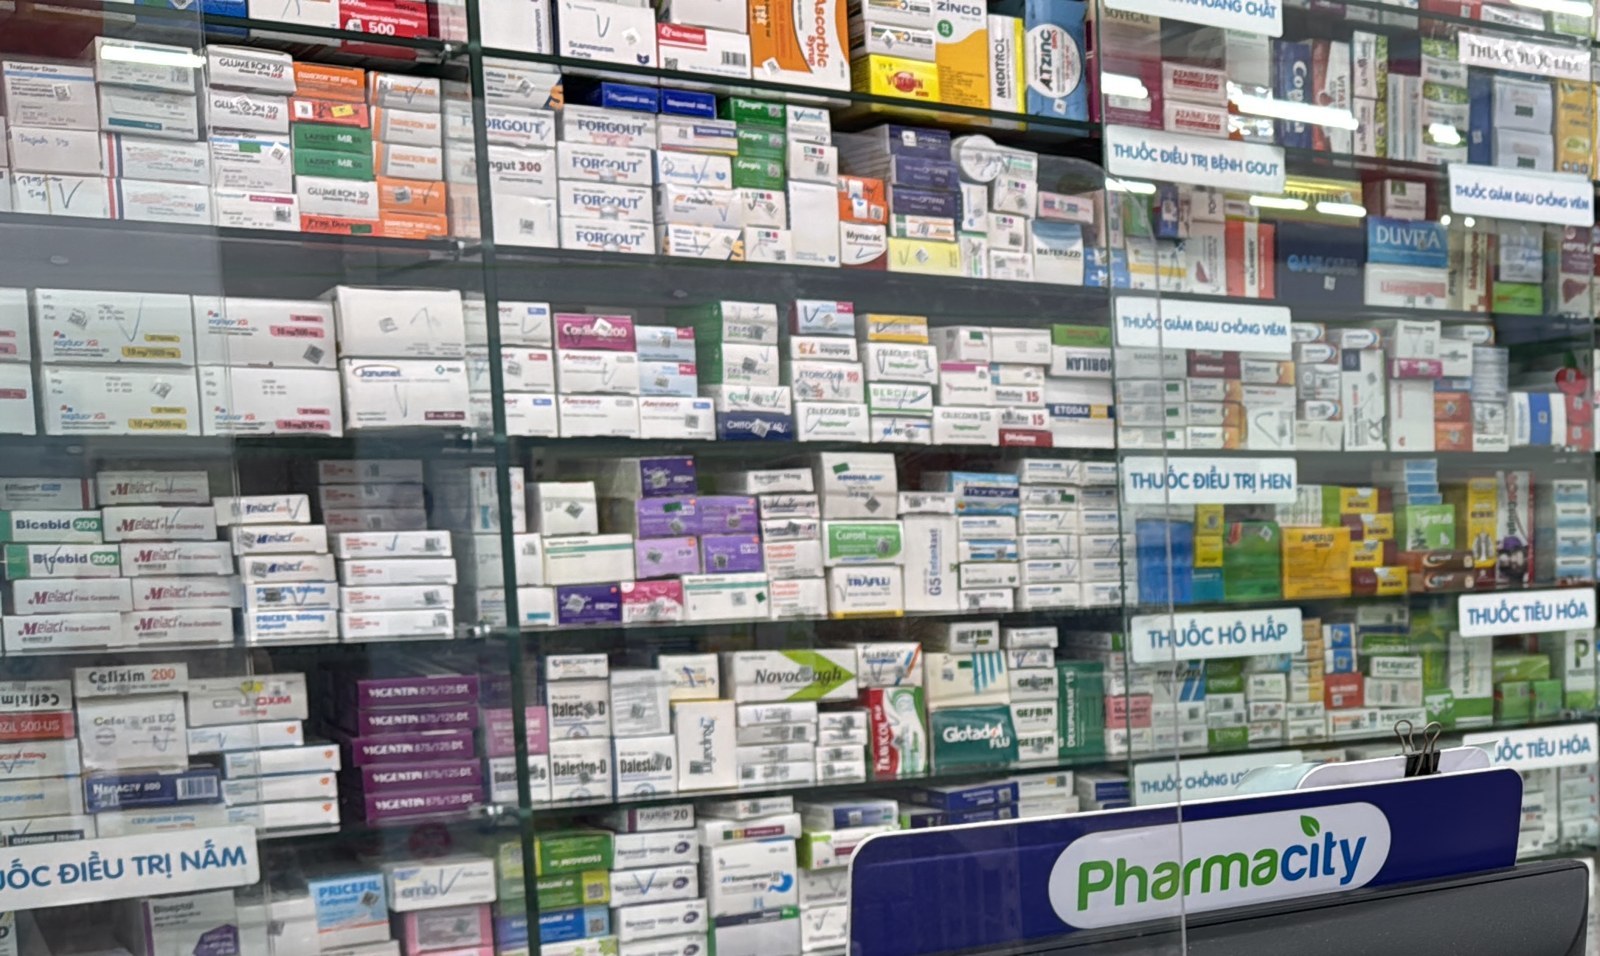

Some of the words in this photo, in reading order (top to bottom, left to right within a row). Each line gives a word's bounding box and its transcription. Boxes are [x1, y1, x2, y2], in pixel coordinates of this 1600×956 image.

[368, 22, 395, 36] 500
[273, 63, 285, 74] 30
[995, 38, 1006, 98] MEDITROL
[578, 118, 643, 136] FORGOUT
[337, 133, 353, 143] MR
[338, 158, 353, 168] MR
[519, 161, 541, 173] 300
[572, 156, 640, 175] FORGOUT
[1246, 161, 1279, 177] GOUT
[573, 193, 640, 210] FORGOUT
[576, 230, 641, 247] FORGOUT
[1376, 224, 1441, 249] DUVITA
[1195, 320, 1220, 333] ĐAU
[361, 366, 400, 378] Janumet
[1026, 391, 1039, 402] 15
[1032, 414, 1044, 426] 15
[1130, 464, 1189, 490] THUỐC
[1193, 465, 1230, 490] ĐIỀU
[1233, 472, 1257, 494] TRỊ
[1260, 473, 1292, 490] HEN
[16, 519, 71, 530] Bicebid
[75, 520, 98, 530] 200
[33, 553, 88, 565] Bicebid
[92, 554, 115, 565] 200
[134, 547, 178, 564] Meiact
[28, 589, 75, 605] Meiact
[1467, 597, 1520, 626] THUỐC
[1523, 601, 1553, 622] TIÊU
[1556, 599, 1589, 620] HÓA
[18, 620, 65, 636] Meiact
[134, 616, 178, 631] Meiact
[1147, 619, 1214, 649] THUỐC
[1218, 621, 1247, 644] HÔ
[1251, 615, 1288, 642] HẤP
[88, 670, 145, 685] Cefixim
[151, 668, 176, 681] 200
[1, 693, 60, 707] Cefixim
[943, 723, 1004, 744] Glotadol
[989, 736, 1011, 749] FLU
[1527, 737, 1556, 760] TIÊU
[1558, 733, 1592, 756] HÓA
[673, 809, 689, 822] 20
[57, 850, 124, 885] ĐIỀU
[131, 852, 172, 879] TRỊ
[181, 839, 247, 873] NẤM
[1077, 828, 1367, 912] Pharmacity
[319, 880, 381, 898] PRICEFIL
